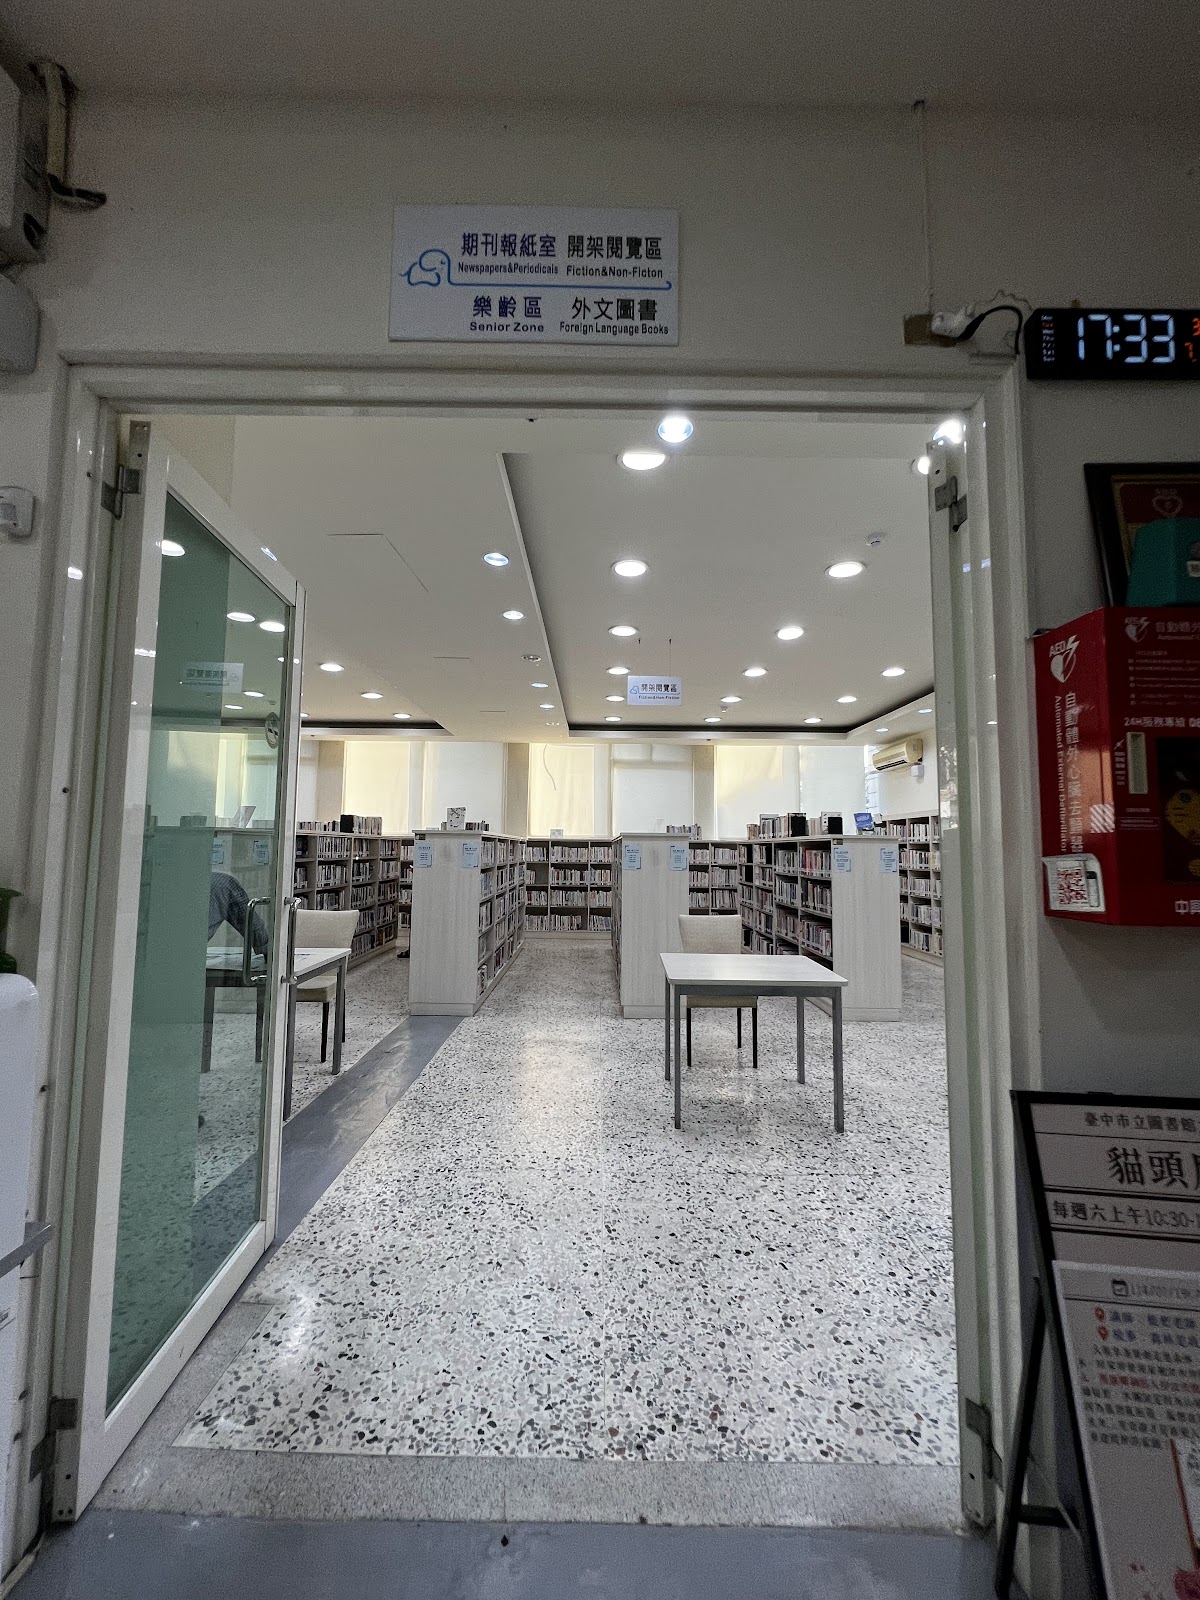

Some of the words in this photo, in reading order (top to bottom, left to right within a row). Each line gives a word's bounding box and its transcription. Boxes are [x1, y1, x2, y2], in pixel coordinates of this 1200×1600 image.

[461, 232, 556, 257] 期刊報紙室
[567, 235, 662, 260] 開架閱覽區
[458, 262, 558, 275] Newspapers&Periodicals
[473, 295, 542, 318] 樂齡區
[571, 296, 657, 321] 外文圖書
[470, 322, 510, 332] Senior
[513, 322, 544, 332] Zone
[559, 321, 593, 335] Foreign
[595, 322, 639, 336] Language
[641, 323, 669, 335] Books
[1077, 313, 1176, 363] 17:33
[1048, 640, 1066, 658] AED
[1054, 695, 1064, 749] Automated
[1056, 751, 1065, 791] External
[1058, 795, 1067, 852] Defibrillator
[1107, 1146, 1200, 1191] 貓頭
